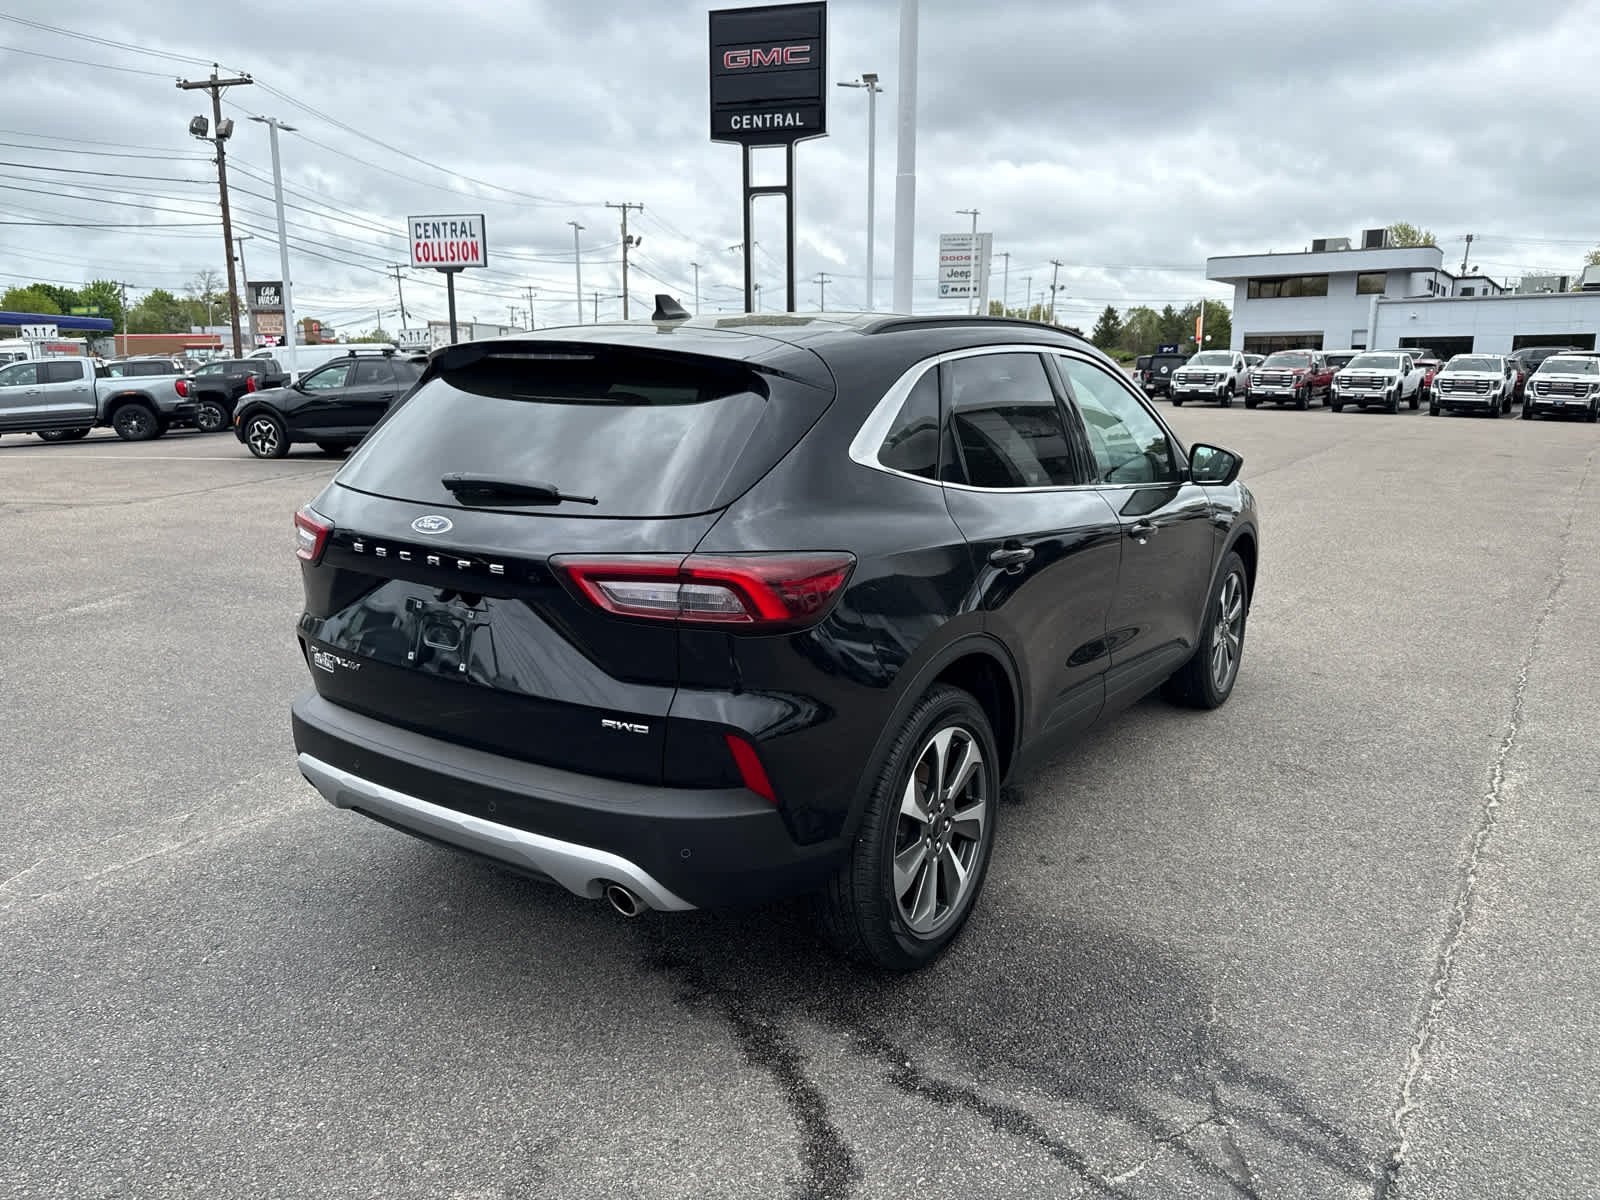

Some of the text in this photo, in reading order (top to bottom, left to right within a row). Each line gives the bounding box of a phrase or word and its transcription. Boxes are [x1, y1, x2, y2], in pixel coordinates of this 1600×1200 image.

[723, 45, 811, 69] GMC
[730, 112, 805, 129] CENTRAL
[414, 221, 477, 240] CENTRAL
[415, 240, 480, 262] COLLISION
[946, 268, 972, 280] Jeep
[257, 295, 280, 305] WASH
[260, 286, 276, 296] CAR
[352, 542, 505, 575] ESCAPE
